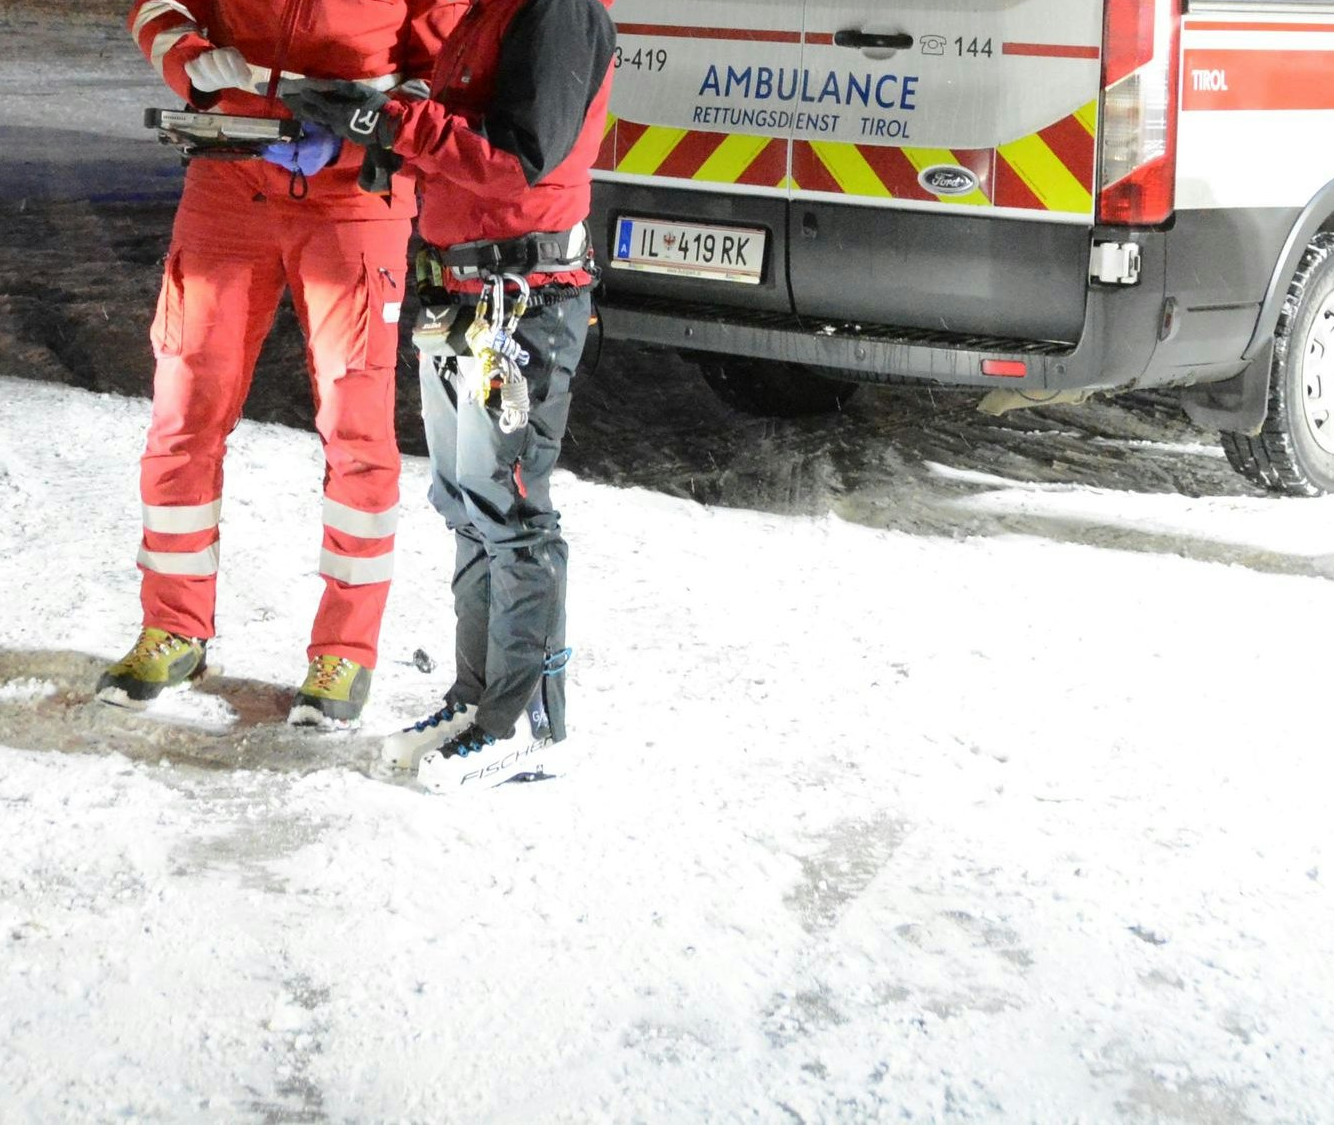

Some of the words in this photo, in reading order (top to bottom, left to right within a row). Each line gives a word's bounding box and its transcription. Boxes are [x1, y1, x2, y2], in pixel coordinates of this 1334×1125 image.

[954, 38, 993, 59] 144
[698, 64, 919, 111] AMBULANCE
[1191, 68, 1229, 92] TIROL
[692, 105, 840, 133] RETTUNGSDIENST
[861, 116, 911, 139] TIROL
